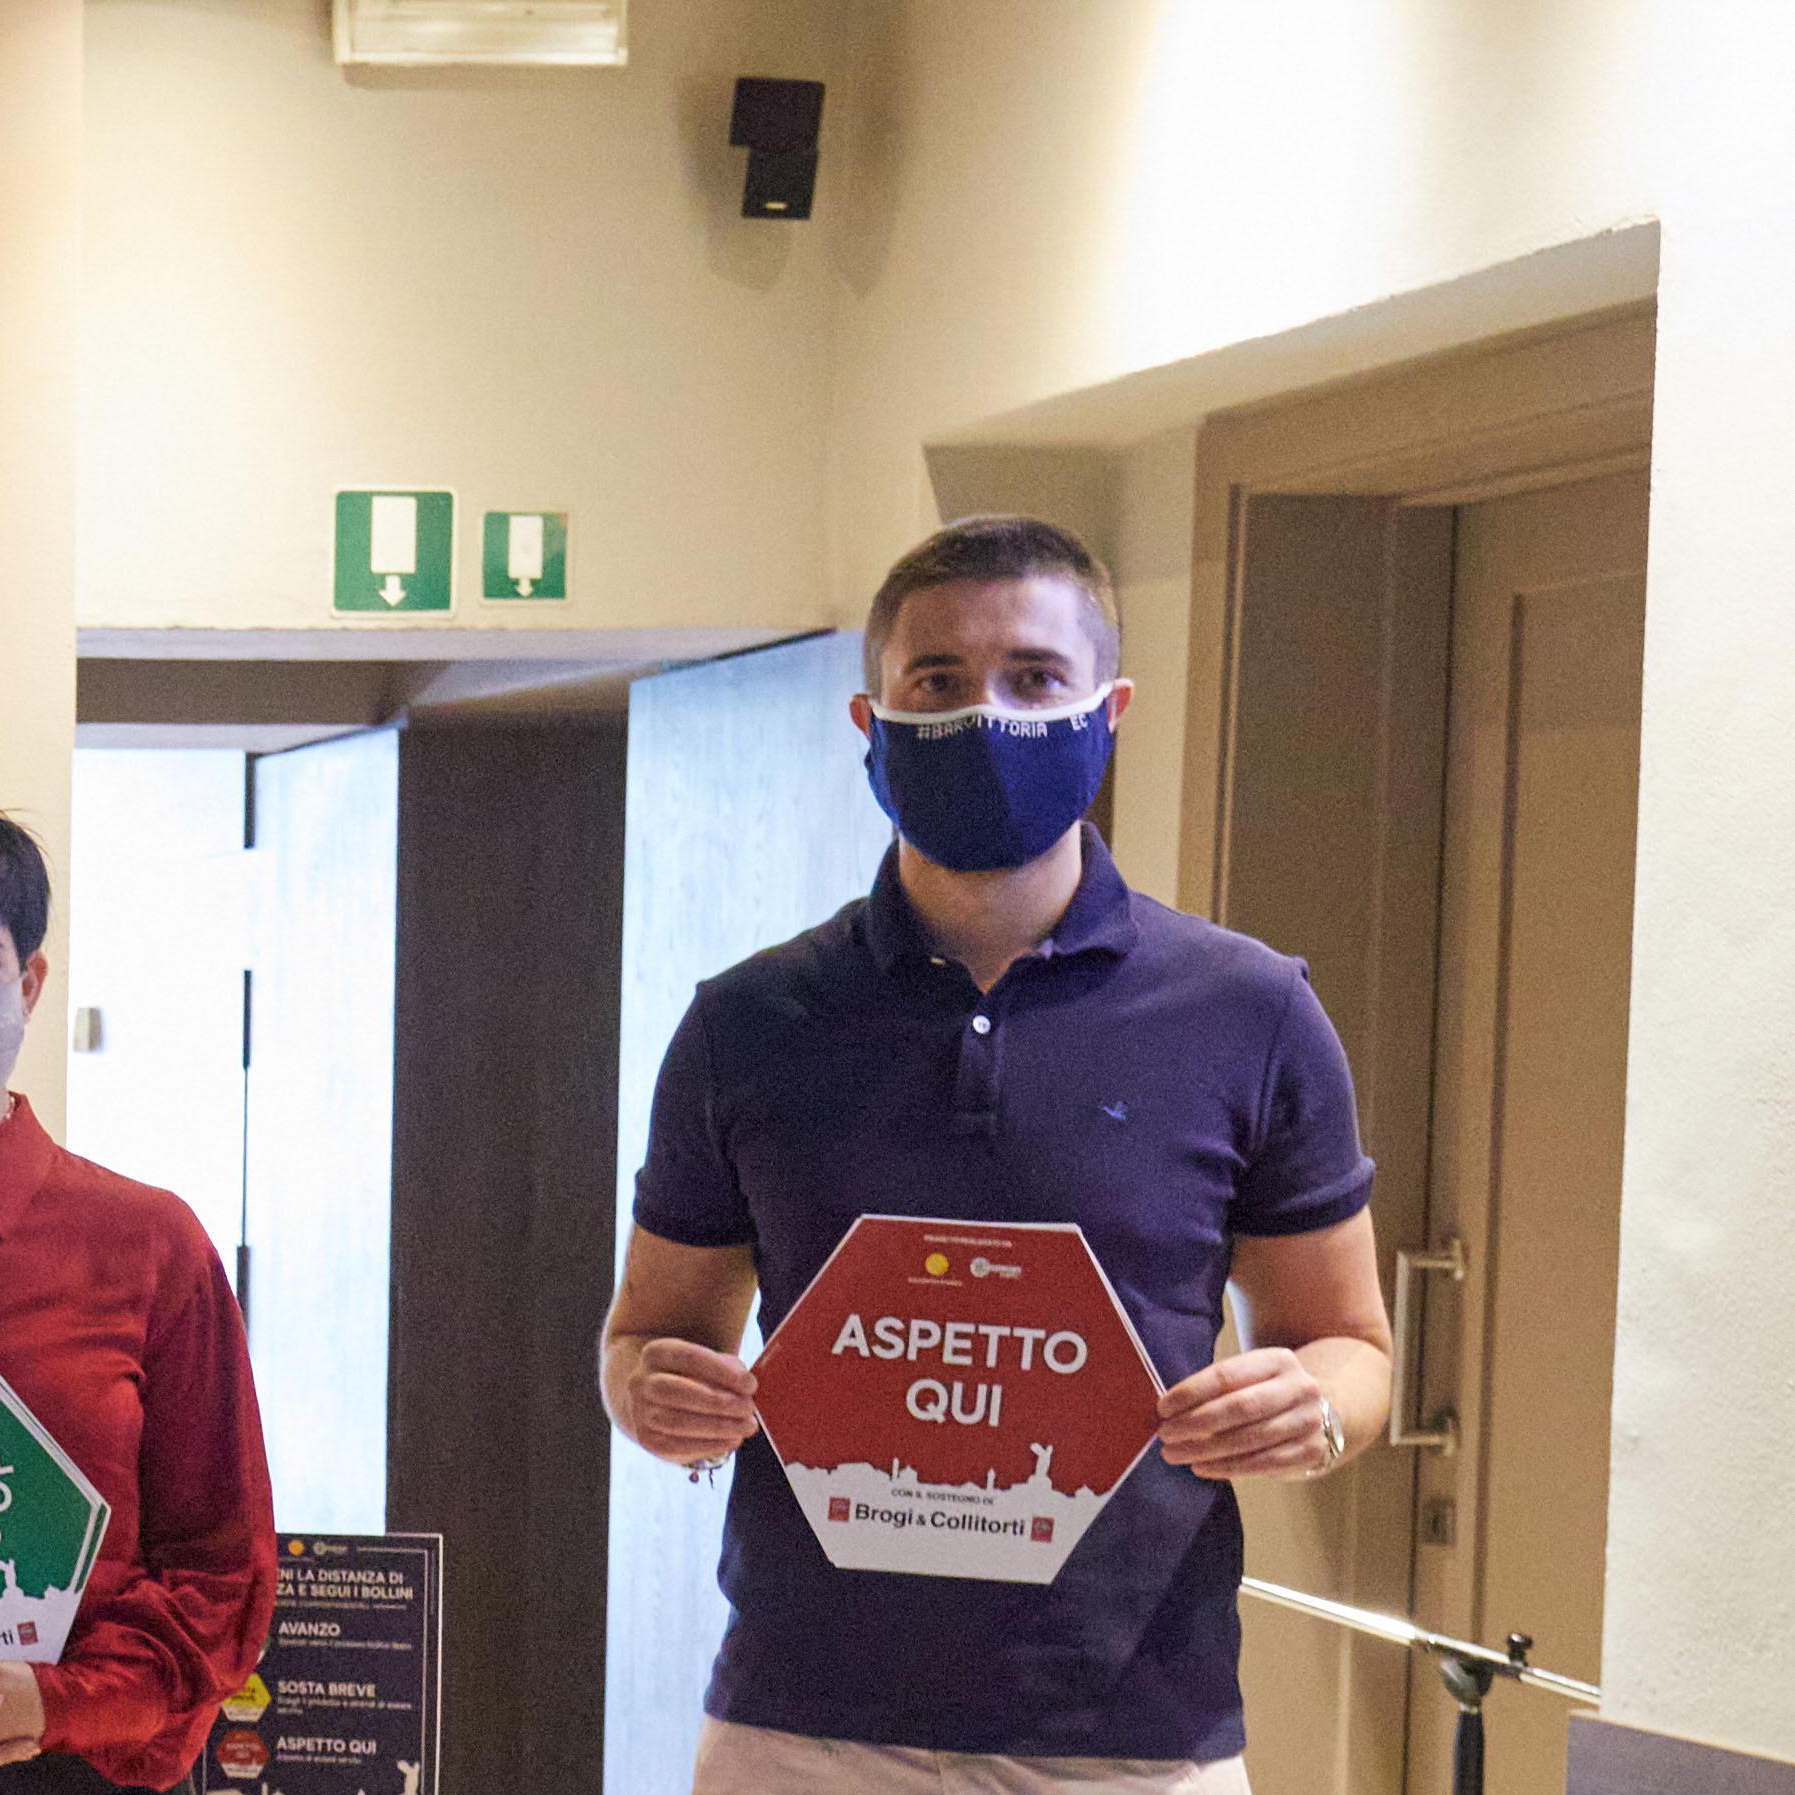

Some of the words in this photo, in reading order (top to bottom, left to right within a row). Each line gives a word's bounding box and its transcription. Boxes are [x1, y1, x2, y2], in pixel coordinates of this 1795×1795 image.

[831, 1313, 1088, 1374] ASPETTO
[906, 1378, 1002, 1427] QUI
[891, 1488, 914, 1499] CON
[926, 1492, 980, 1504] SOSTEGNO
[855, 1504, 913, 1528] Brogi
[916, 1515, 926, 1526] &
[931, 1511, 1025, 1536] Collitorti
[297, 1570, 314, 1581] LA
[318, 1570, 385, 1584] DISTANZA
[389, 1572, 403, 1585] DI
[298, 1585, 307, 1596] E
[310, 1586, 351, 1598] SEGUI
[361, 1587, 413, 1600] BOLLINI
[279, 1622, 341, 1636] AVANZO
[277, 1681, 325, 1695] SOSTA
[328, 1682, 377, 1697] BREVE
[277, 1736, 346, 1752] ASPETTO
[349, 1739, 377, 1755] QUI
